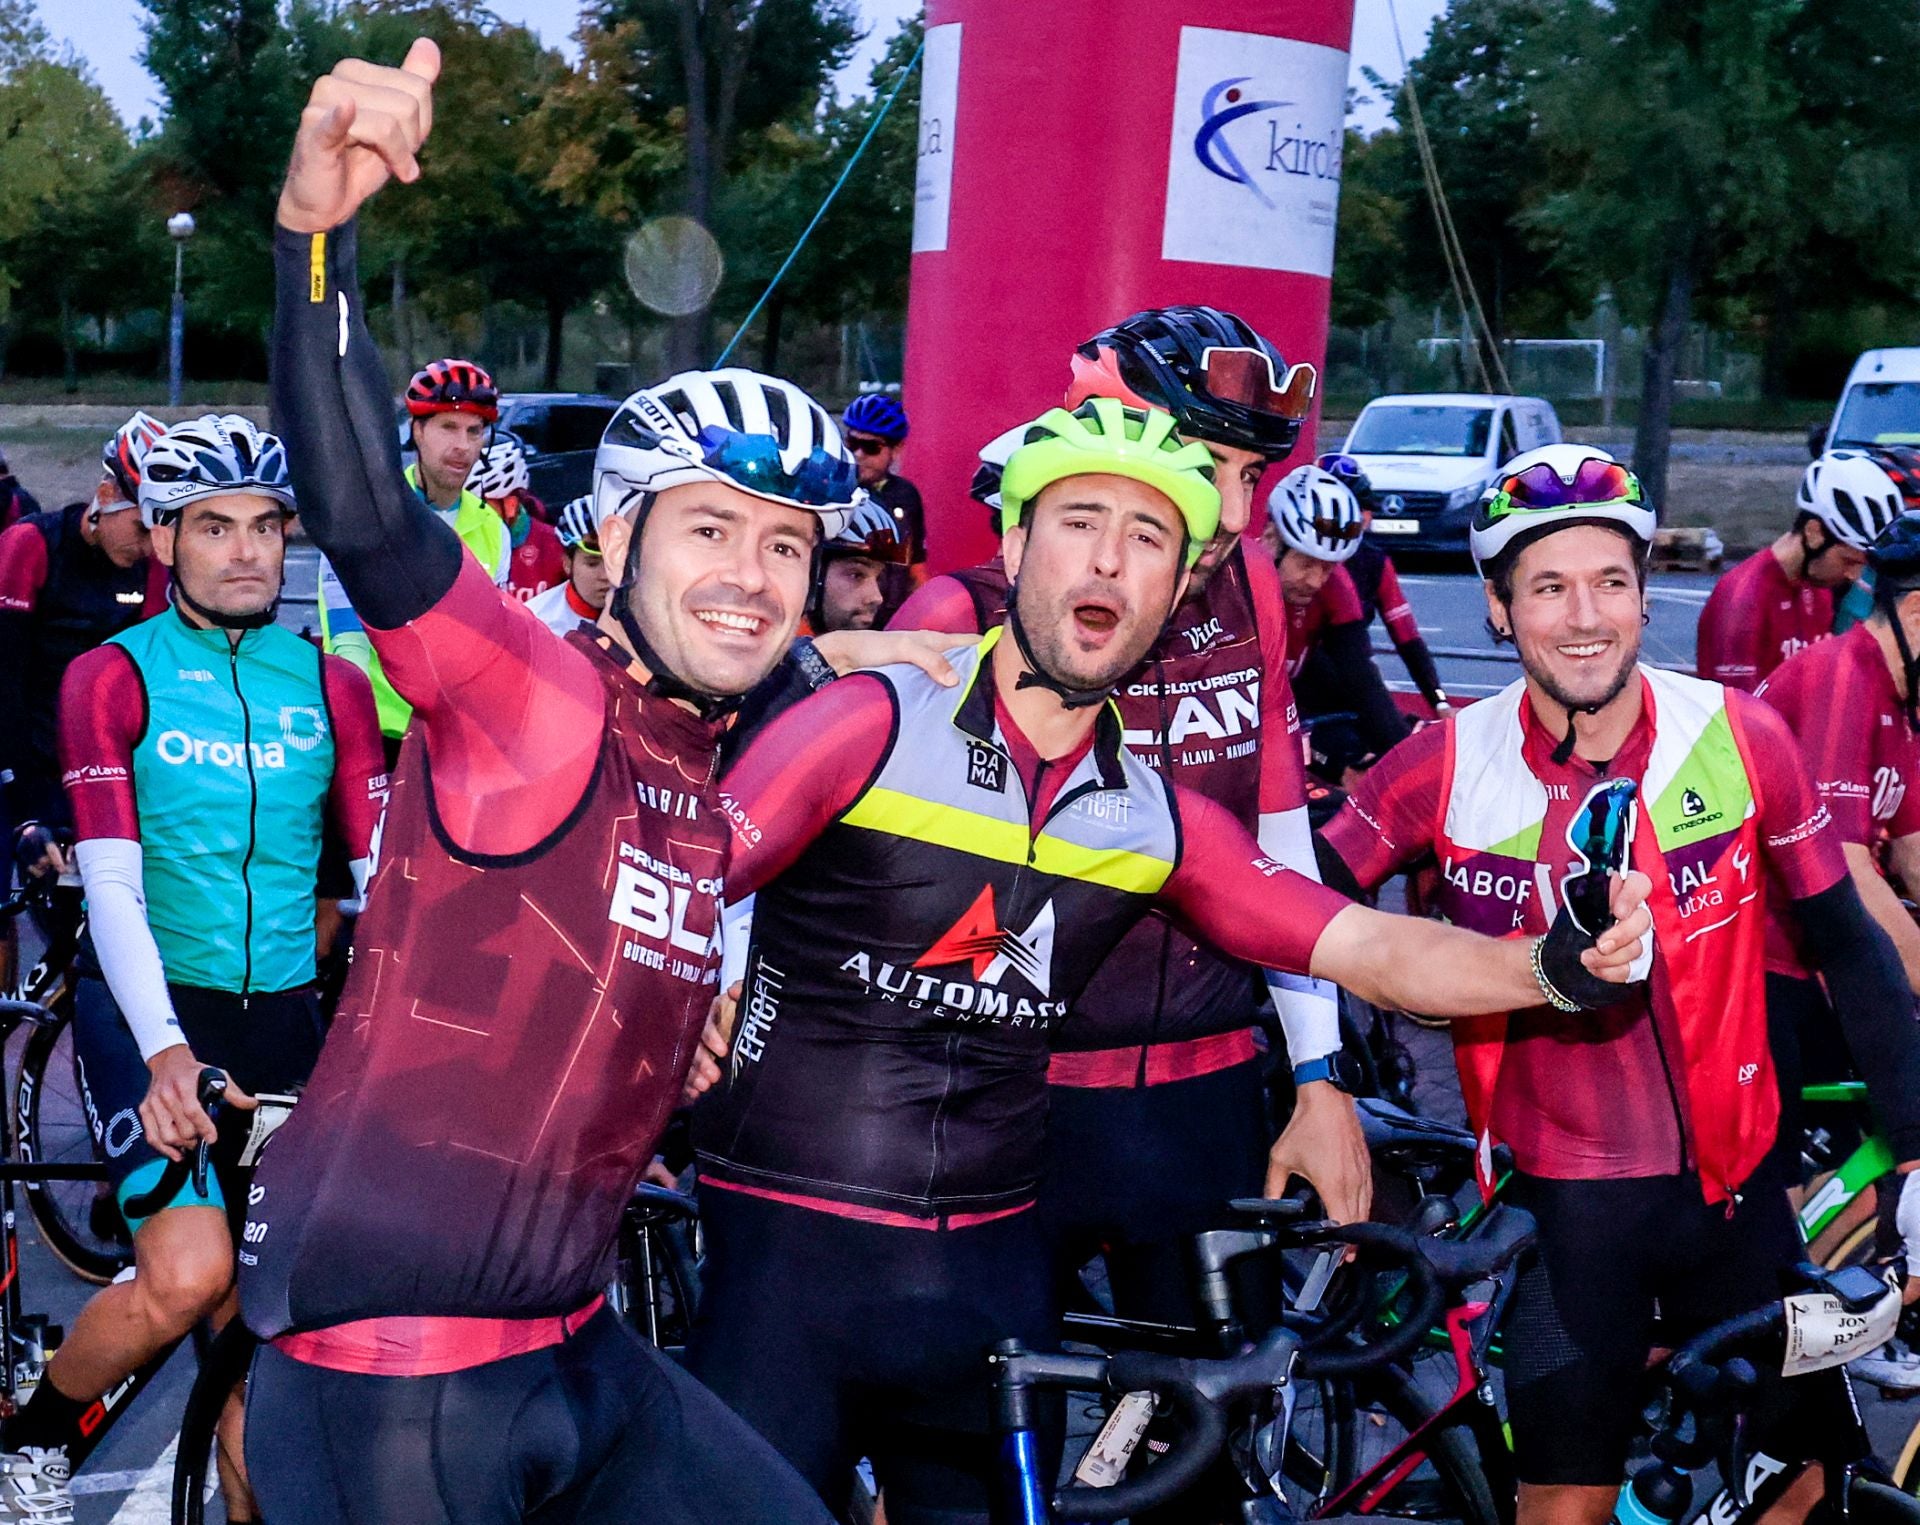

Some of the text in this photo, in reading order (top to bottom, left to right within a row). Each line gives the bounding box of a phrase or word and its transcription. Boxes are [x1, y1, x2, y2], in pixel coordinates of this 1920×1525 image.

[634, 395, 676, 432] SCOTT
[157, 730, 286, 769] Orona
[636, 781, 698, 820] GOBIK
[1672, 811, 1724, 834] ETXEONDO
[619, 841, 693, 886] PRUEBA
[1678, 889, 1724, 919] utxa
[622, 940, 666, 971] BURGOS
